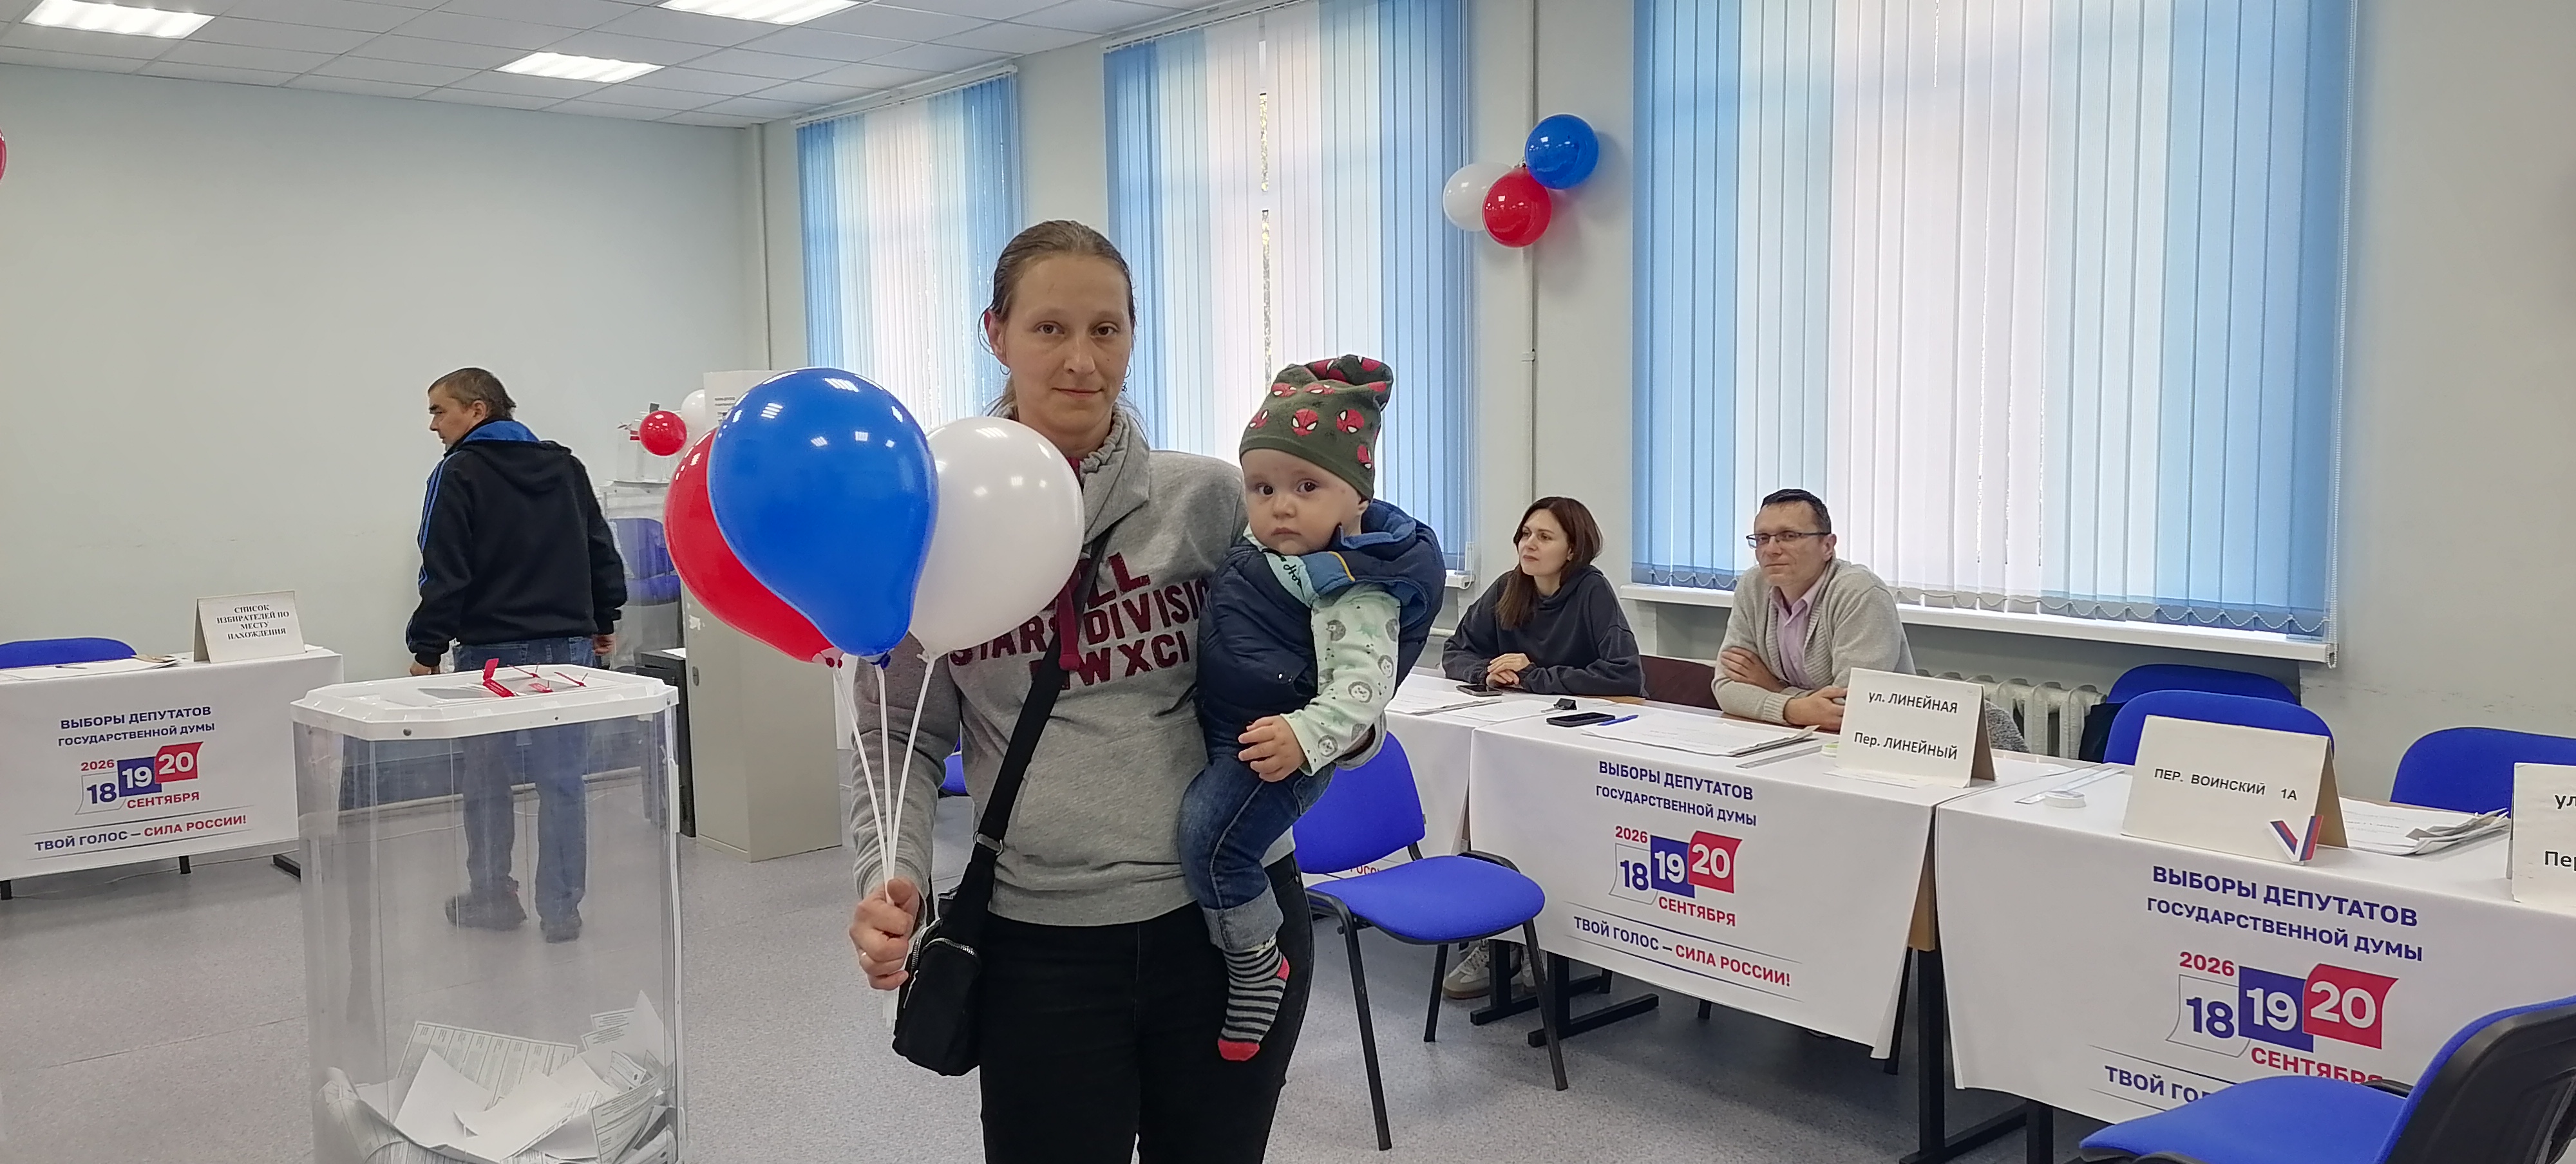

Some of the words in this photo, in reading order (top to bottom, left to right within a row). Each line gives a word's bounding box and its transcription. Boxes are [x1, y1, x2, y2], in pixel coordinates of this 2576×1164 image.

[216, 611, 276, 624] ИЗБИРАТЕЛЕЙ
[234, 604, 270, 614] СПИСОК
[227, 628, 287, 641] НАХОЖДЕНИЯ
[240, 621, 269, 630] МЕСТУ
[1868, 692, 1885, 703] ул.
[1888, 693, 1958, 713] ЛИНЕЙНАЯ
[61, 714, 125, 729] ВЫБОРЫ
[129, 706, 211, 724] ДЕПУТАТОВ
[58, 725, 177, 747] ГОСУДАРСТВЕННОЙ
[180, 723, 215, 735] ДУМЫ
[1854, 732, 1880, 749] Пер.
[1883, 737, 1958, 760] ЛИНЕЙНЫЙ
[80, 759, 115, 771] 2026
[86, 782, 117, 804] 18
[122, 766, 152, 789] 19
[158, 751, 194, 774] 20
[1599, 760, 1660, 784] ВЫБОРЫ
[1663, 773, 1753, 800] ДЕПУТАТОВ
[2154, 768, 2184, 782] ПЕР.
[2190, 774, 2265, 796] ВОИНСКИЙ
[2280, 789, 2298, 801] 1А
[127, 791, 200, 809] СЕНТЯБРЯ
[1595, 785, 1714, 818] ГОСУДАРСТВЕННОЙ
[1717, 809, 1757, 826] ДУМЫ
[35, 836, 75, 851] ТВОЙ
[79, 831, 128, 846] ГОЛОС
[144, 820, 182, 836] СИЛА
[186, 814, 247, 831] РОССИИ!
[1615, 825, 1648, 843] 2026
[1620, 859, 1649, 891] 18
[1654, 850, 1685, 883] 19
[1691, 843, 1730, 879] 20
[2544, 850, 2576, 872] Пе
[2152, 865, 2257, 899] ВЫБОРЫ
[2263, 885, 2418, 927] ДЕПУТАТОВ
[1659, 896, 1736, 926] СЕНТЯБРЯ
[2147, 897, 2348, 948] ГОСУДАРСТВЕННОЙ
[2354, 936, 2423, 962] ДУМЫ
[1573, 915, 1609, 937] ТВОЙ
[1613, 927, 1659, 951] ГОЛОС
[1676, 944, 1716, 966] СИЛА
[1720, 956, 1790, 987] РОССИИ!
[2179, 951, 2235, 977] 2026
[2185, 997, 2235, 1039] 18
[2245, 986, 2298, 1032] 19
[2309, 981, 2376, 1029] 20
[2105, 1065, 2164, 1096] ТВОЙ
